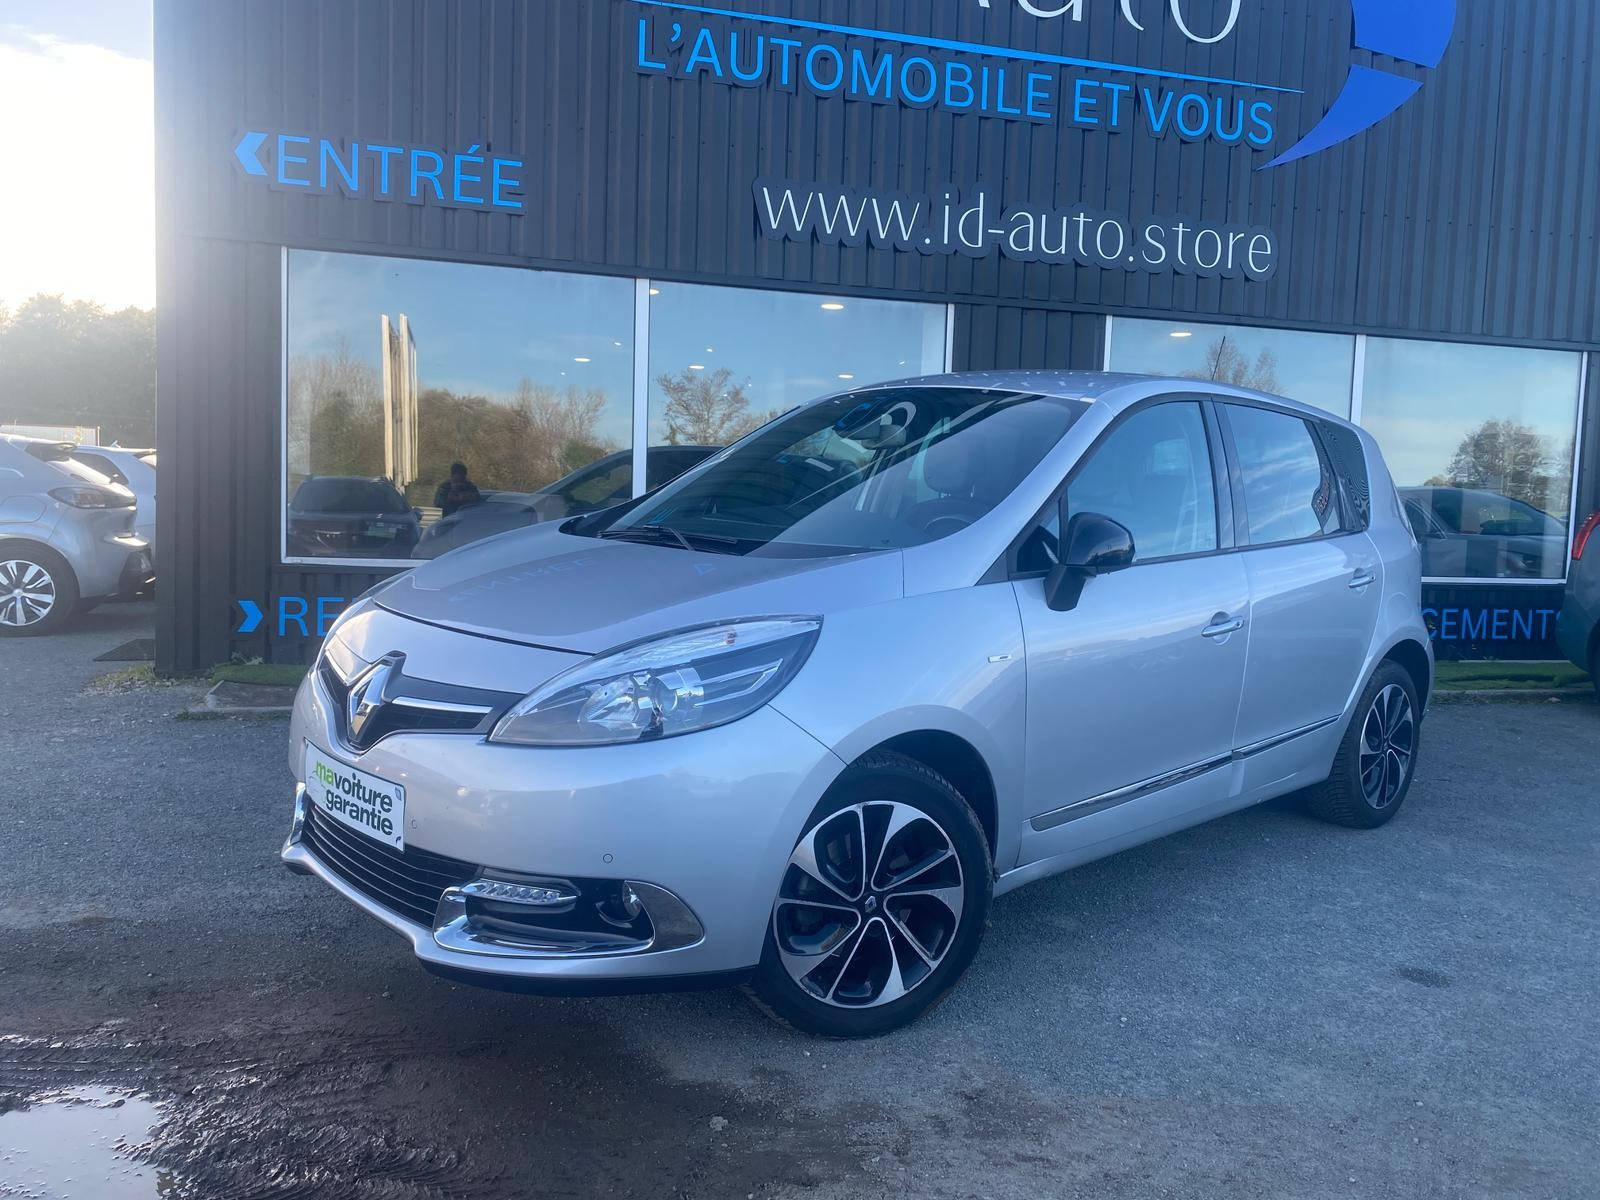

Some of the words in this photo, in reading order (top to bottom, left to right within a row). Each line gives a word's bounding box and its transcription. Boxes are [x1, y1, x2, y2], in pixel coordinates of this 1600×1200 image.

[638, 19, 1052, 118] L'AUTOMOBILE
[1074, 79, 1130, 127] ET
[1143, 88, 1273, 144] VOUS
[277, 133, 523, 208] ENTRÉE
[763, 187, 1271, 272] www.id-auto.store
[1421, 608, 1560, 639] CEMENT
[316, 760, 393, 813] mavoiture
[326, 789, 393, 836] garantie
